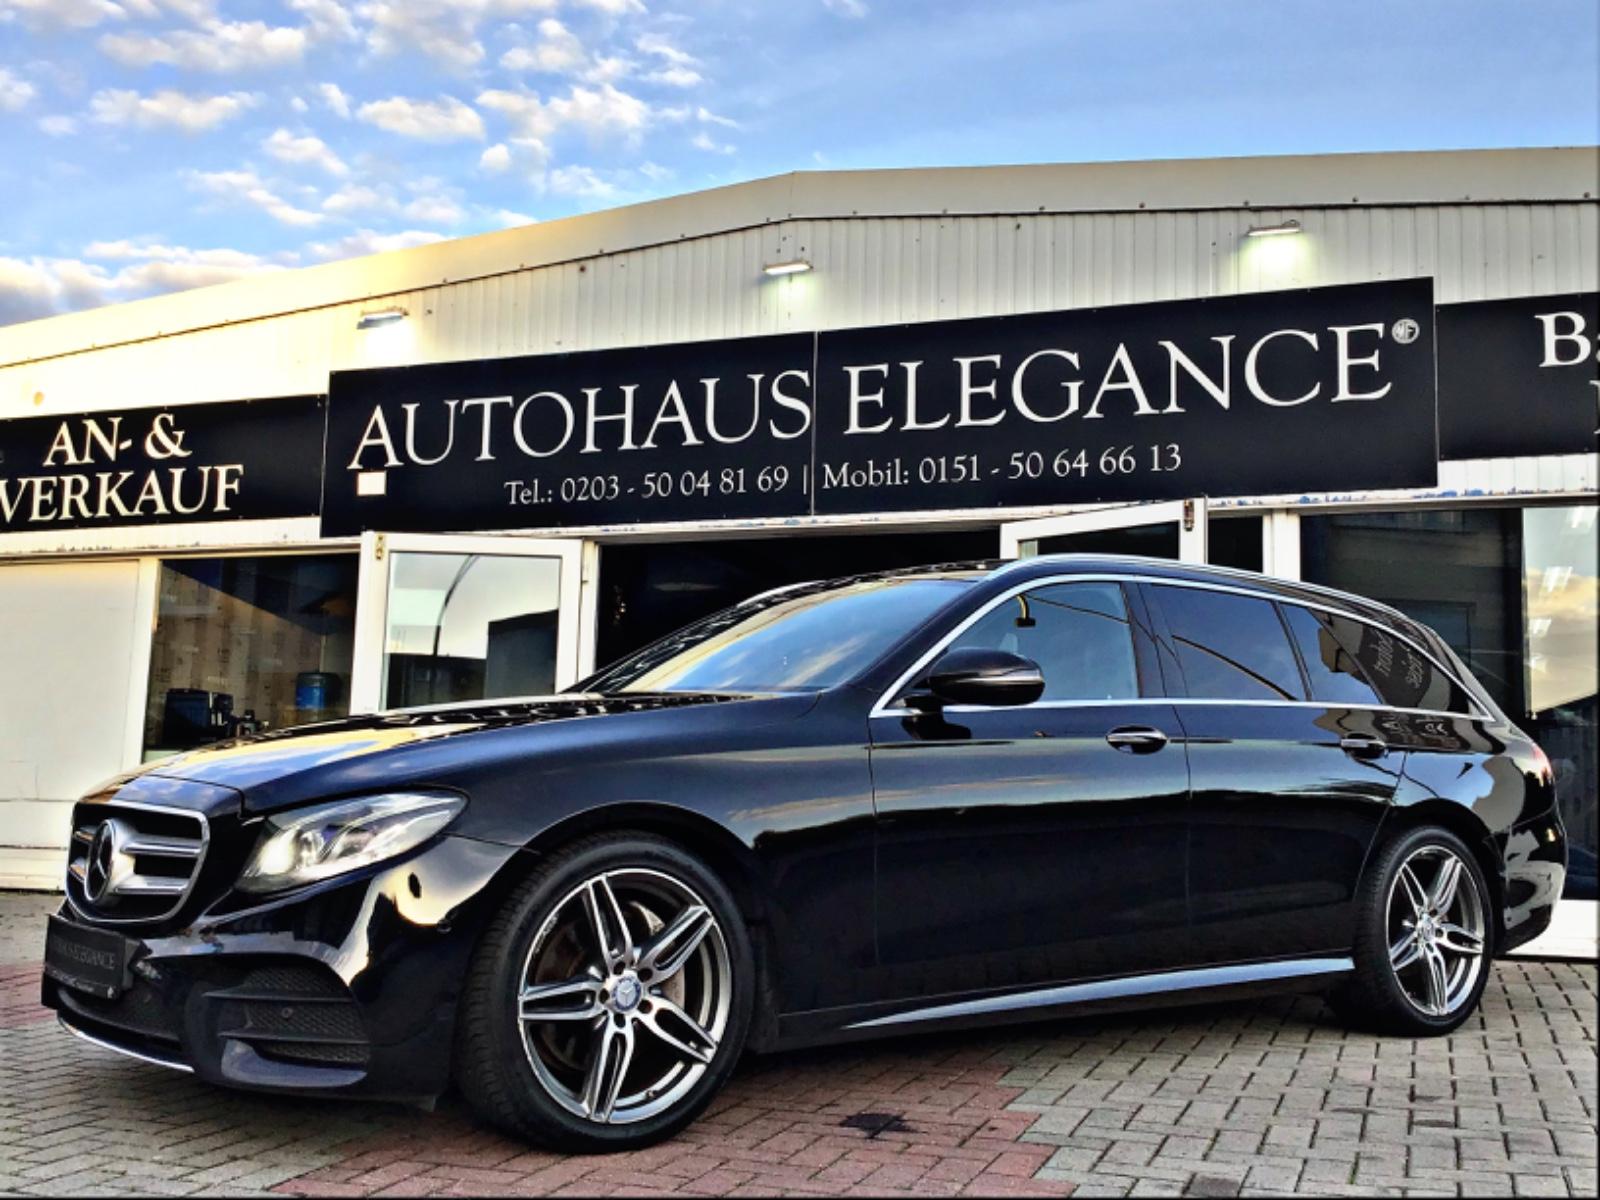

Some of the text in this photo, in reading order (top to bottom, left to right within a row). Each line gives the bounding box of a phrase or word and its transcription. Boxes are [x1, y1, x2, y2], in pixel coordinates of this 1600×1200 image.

[347, 323, 1392, 469] AUTOHAUS ELEGANCE
[43, 413, 193, 466] AN- &
[0, 464, 244, 523] VERKAUF
[504, 478, 552, 505] Tel.:
[560, 475, 620, 502] 0203
[643, 471, 673, 498] 50
[679, 470, 711, 497] 04
[719, 468, 746, 494] 81
[757, 465, 789, 492] 69
[822, 458, 909, 489] Mobil:
[918, 454, 981, 483] 0151
[1009, 451, 1044, 478] 50
[1052, 448, 1090, 476] 64
[1099, 445, 1136, 473] 66
[1150, 443, 1182, 469] 13
